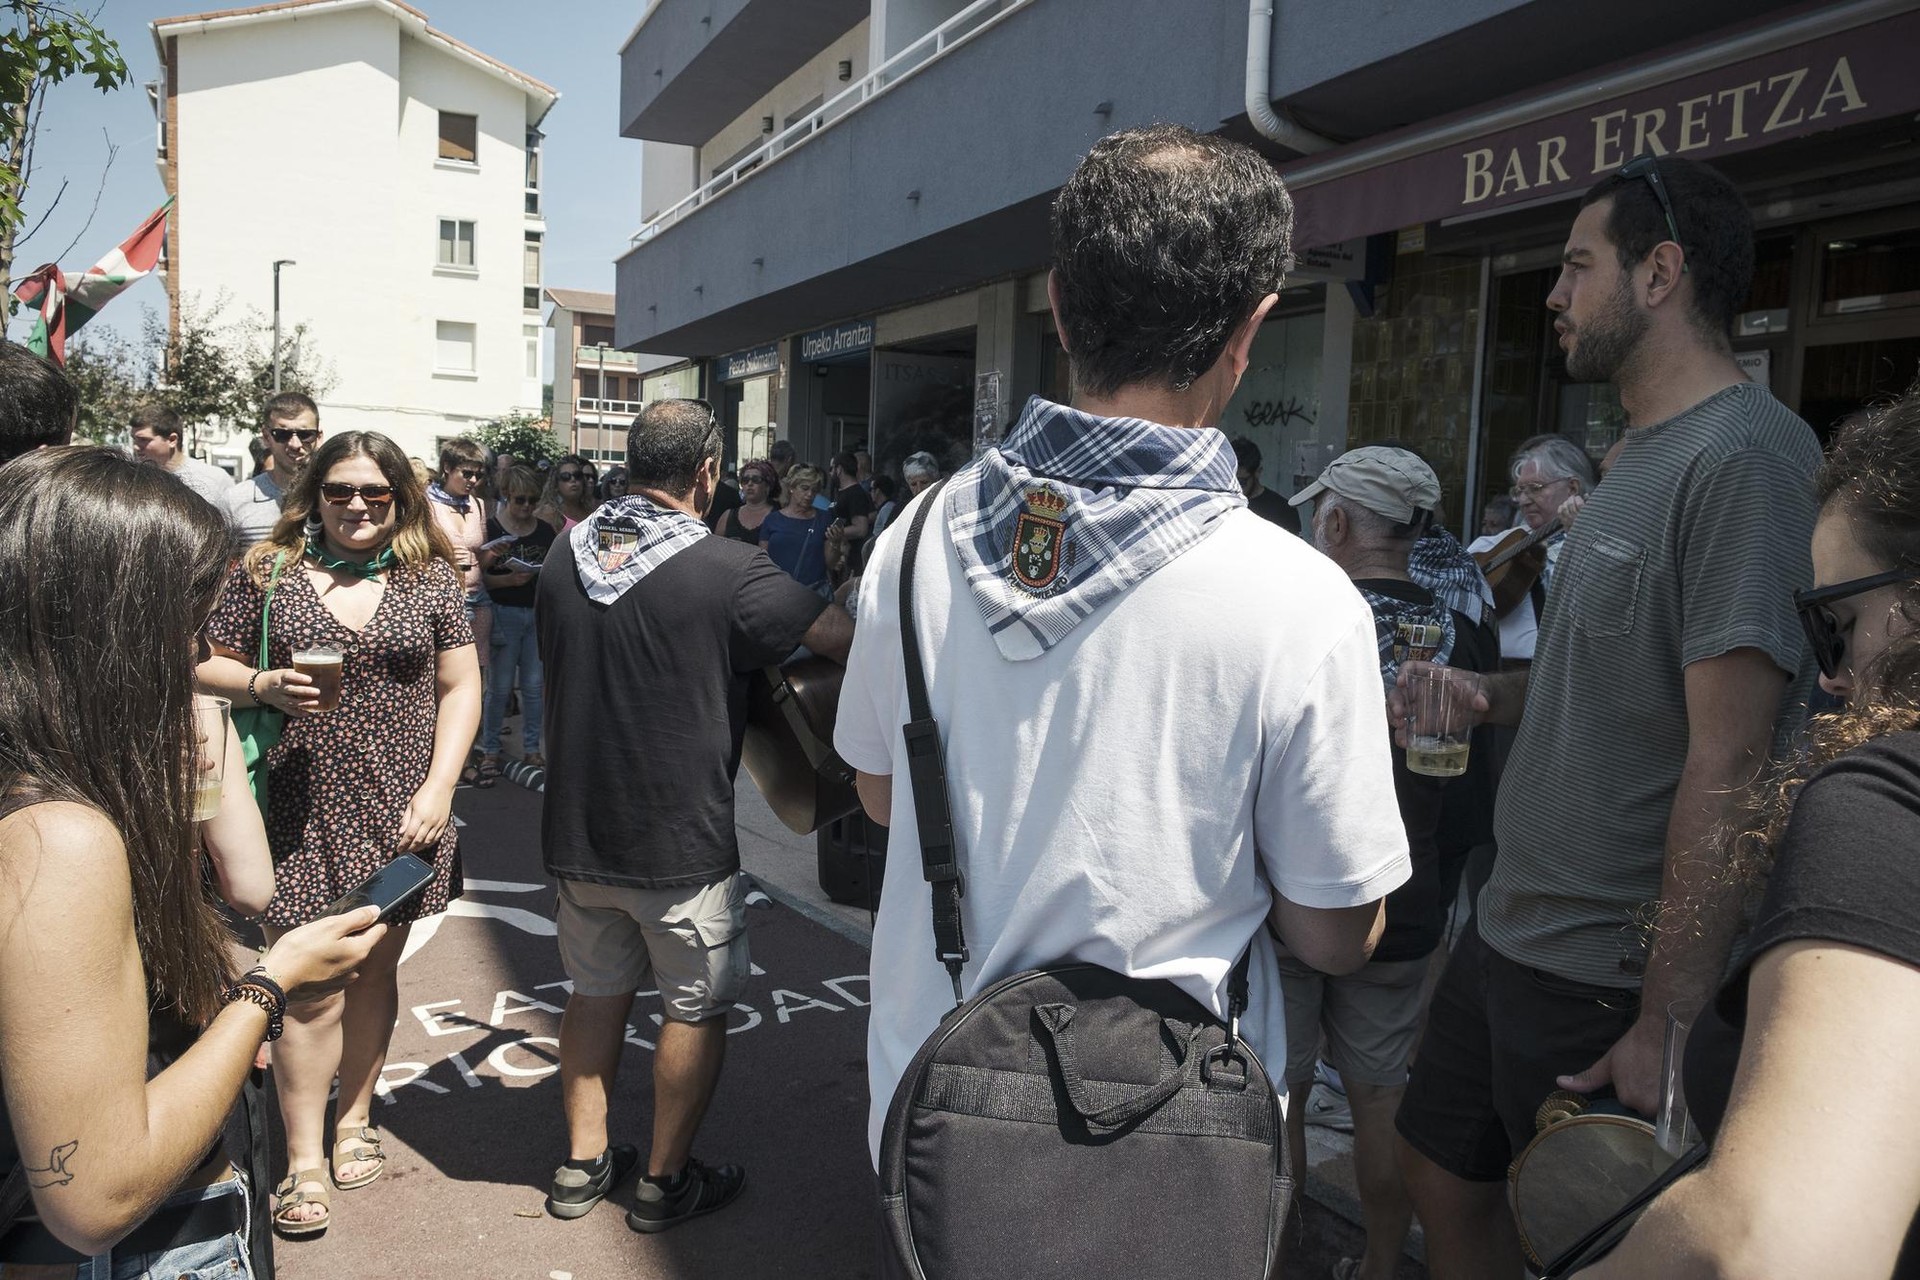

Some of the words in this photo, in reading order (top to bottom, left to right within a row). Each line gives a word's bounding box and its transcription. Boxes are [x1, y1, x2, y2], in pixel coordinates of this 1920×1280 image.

[1462, 134, 1570, 204] BAR
[1590, 56, 1867, 174] ERETZA
[802, 331, 832, 360] Urpeko
[833, 324, 872, 352] Arrantza
[728, 357, 746, 377] Pesca
[746, 346, 779, 372] Submarin
